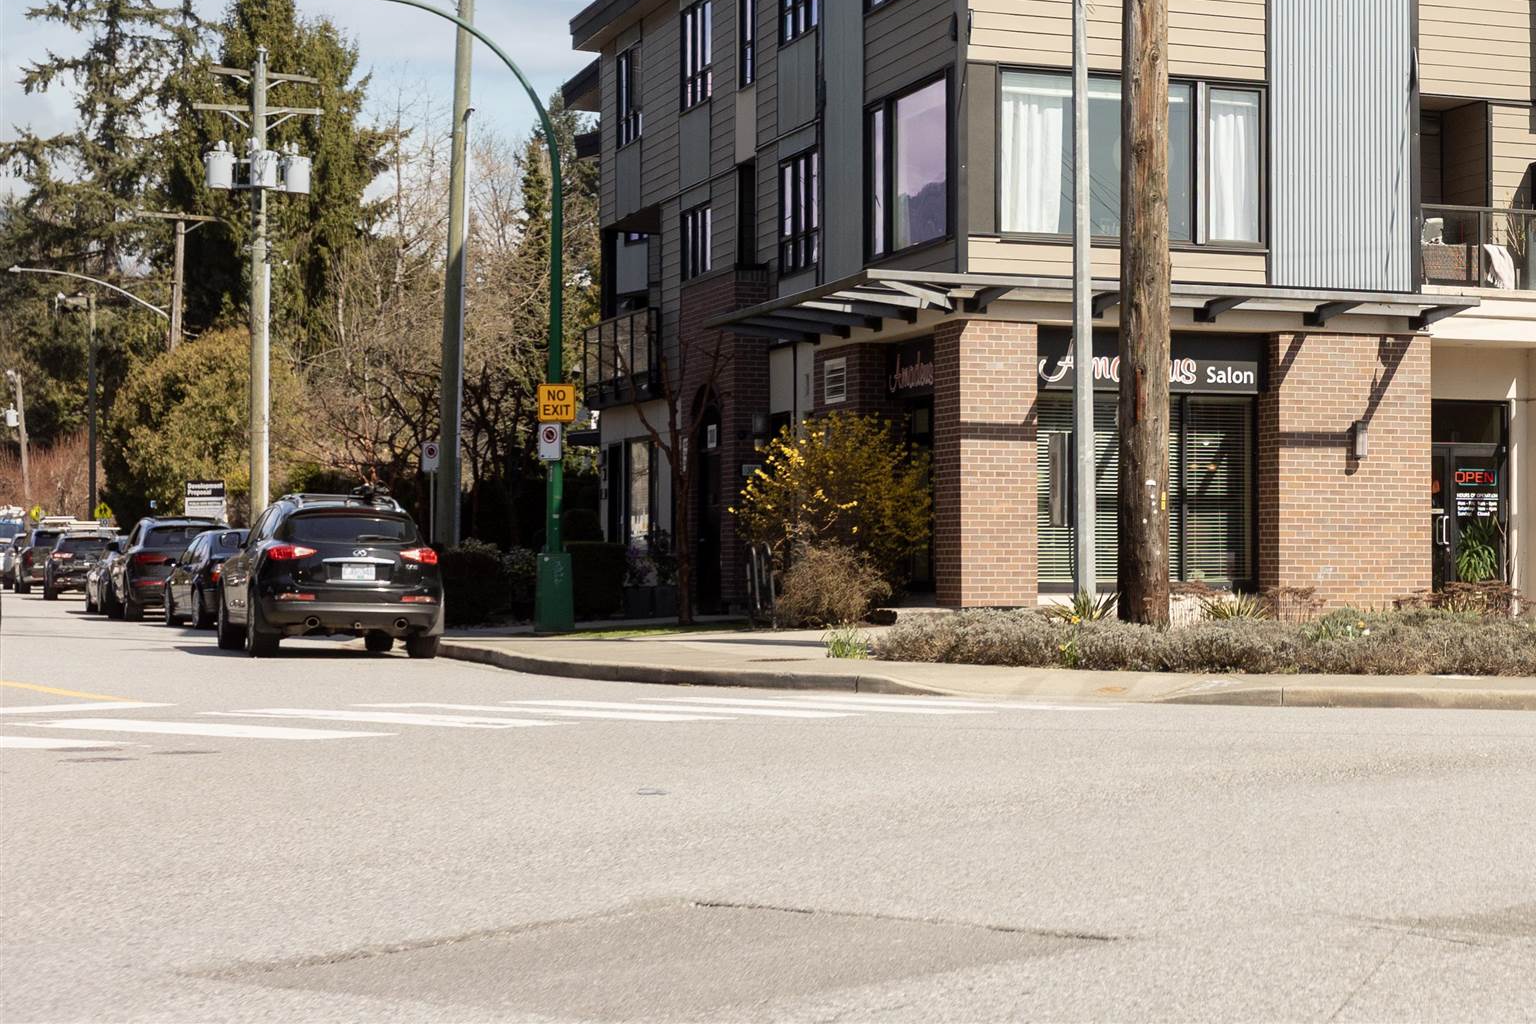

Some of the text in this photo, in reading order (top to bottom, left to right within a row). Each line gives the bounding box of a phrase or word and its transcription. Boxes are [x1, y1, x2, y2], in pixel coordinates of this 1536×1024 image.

[1206, 366, 1254, 384] Salon
[547, 390, 566, 401] NO
[543, 404, 571, 416] EXIT
[1455, 472, 1494, 483] OPEN
